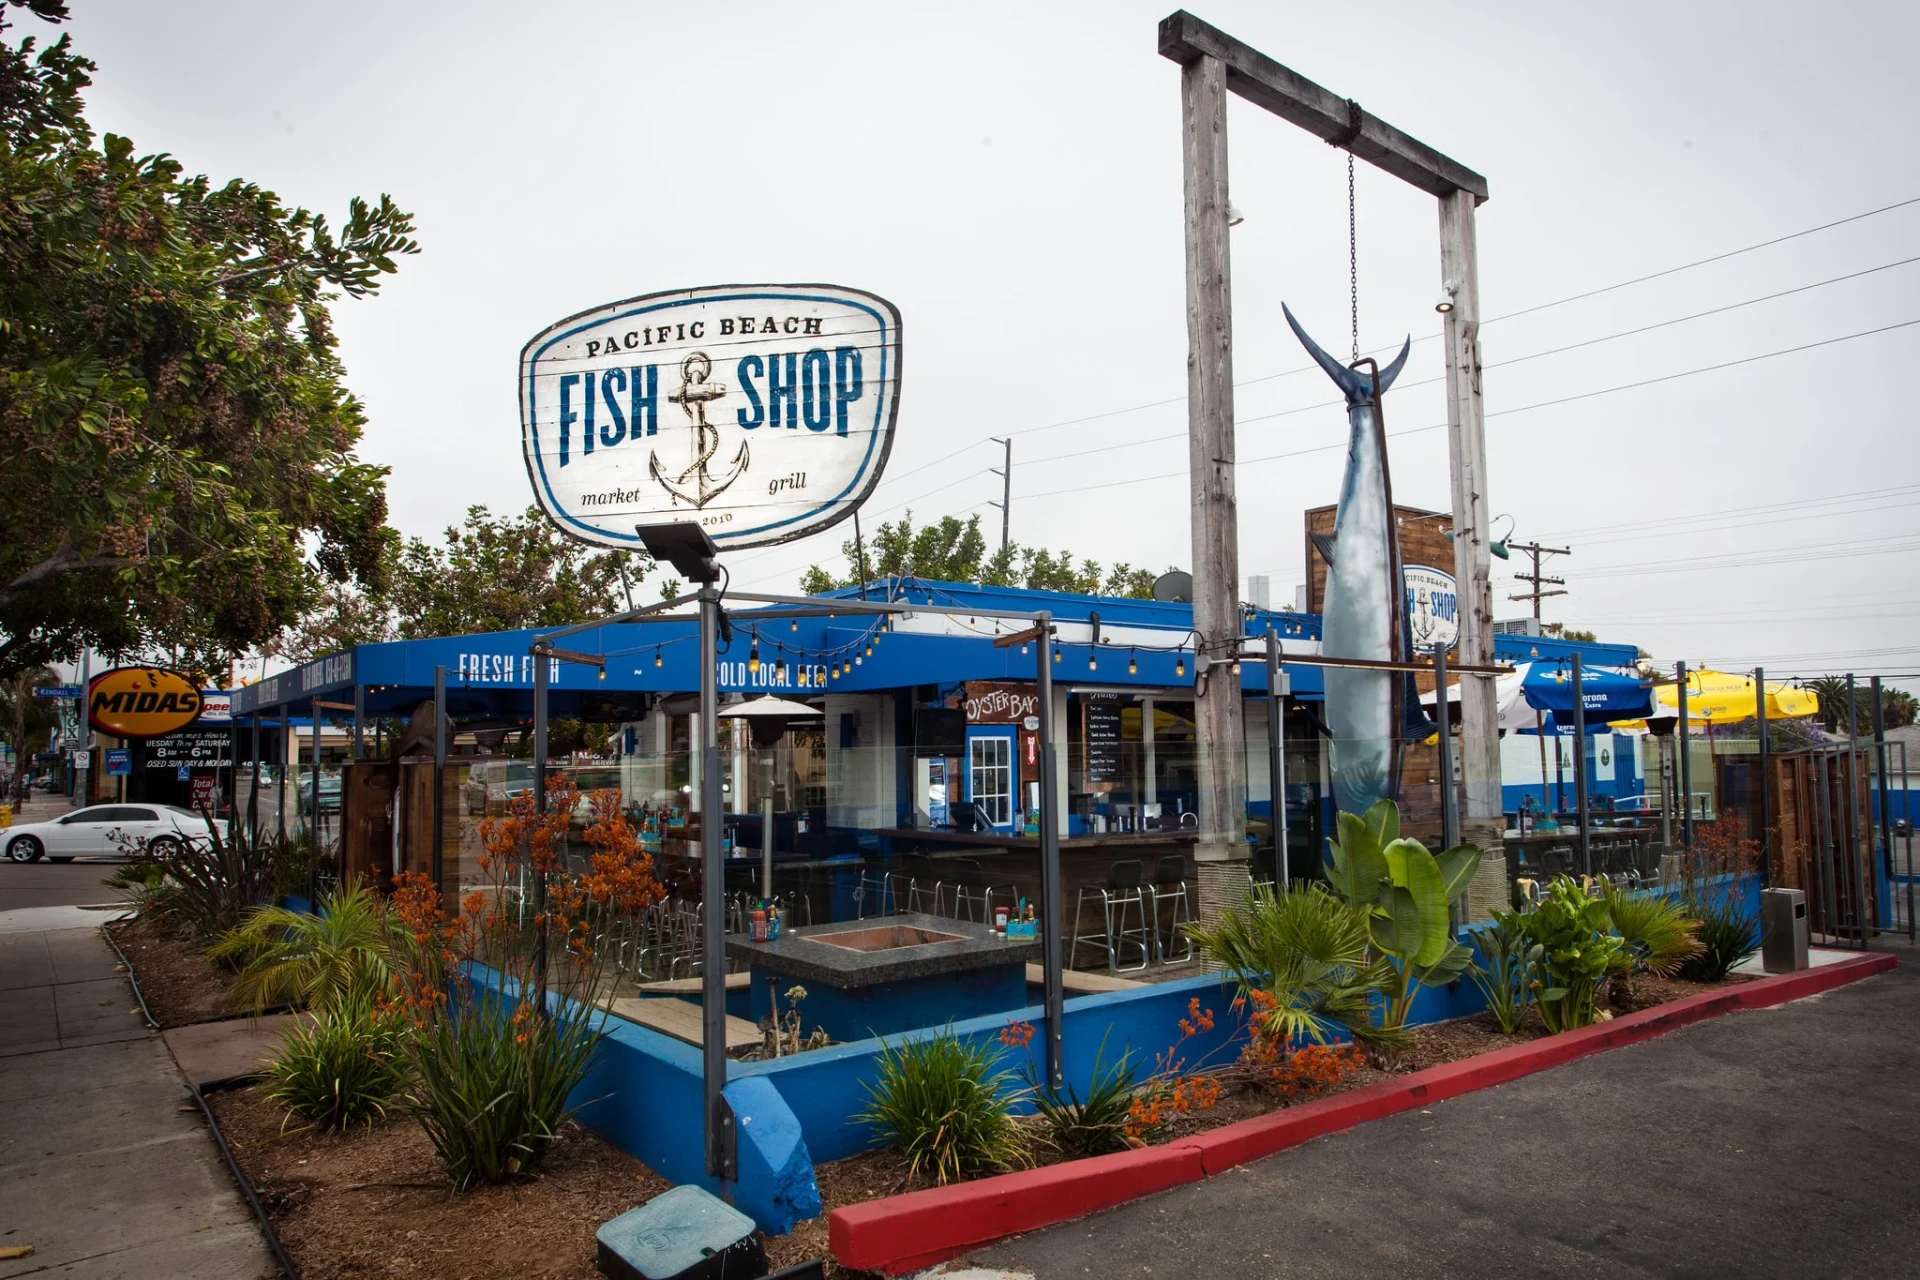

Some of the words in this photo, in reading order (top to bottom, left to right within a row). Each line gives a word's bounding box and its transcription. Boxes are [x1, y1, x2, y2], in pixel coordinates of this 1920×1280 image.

[586, 321, 706, 358] PACIFIC
[719, 316, 824, 336] BEACH
[560, 364, 658, 468] FISH
[736, 345, 863, 438] SHOP
[768, 472, 807, 495] grill
[580, 487, 641, 507] market
[702, 513, 732, 526] 2010
[1406, 574, 1425, 582] CIFIC
[1426, 577, 1448, 589] BEACH
[1430, 591, 1457, 624] SHOP
[459, 653, 514, 683] FRESH
[522, 656, 559, 683] FIH
[40, 688, 69, 696] KENDALL
[91, 682, 199, 714] MIDAS
[1582, 693, 1608, 702] orona
[966, 689, 1010, 720] OYSTER
[204, 731, 229, 739] Hours
[157, 747, 167, 757] 8
[191, 747, 201, 757] 6
[146, 760, 167, 768] OSED
[193, 779, 214, 788] Total
[192, 800, 213, 809] Cre
